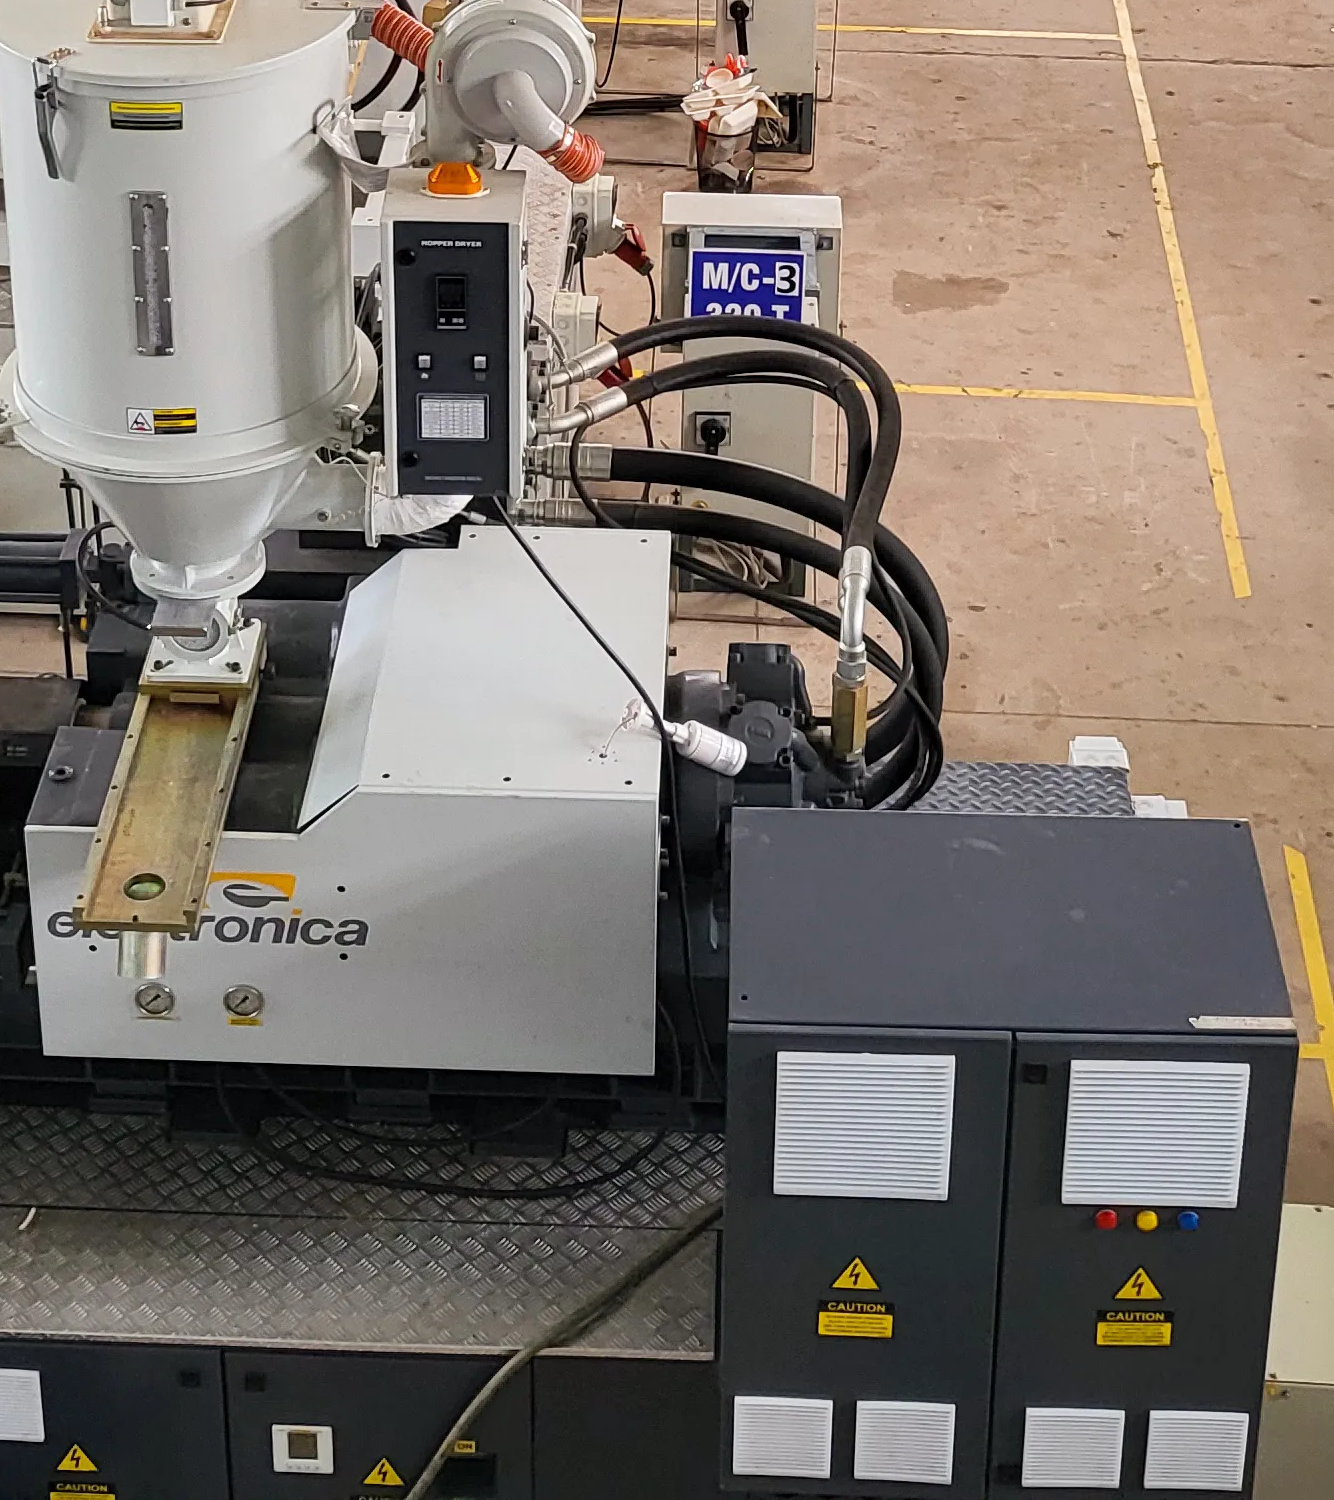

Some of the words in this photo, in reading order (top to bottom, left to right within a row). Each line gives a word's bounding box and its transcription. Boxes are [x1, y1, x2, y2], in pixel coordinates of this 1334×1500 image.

[702, 262, 796, 293] M/C-3
[827, 1301, 886, 1313] CAUTION
[1106, 1311, 1165, 1322] CAUTION
[56, 1482, 108, 1493] CAUTION
